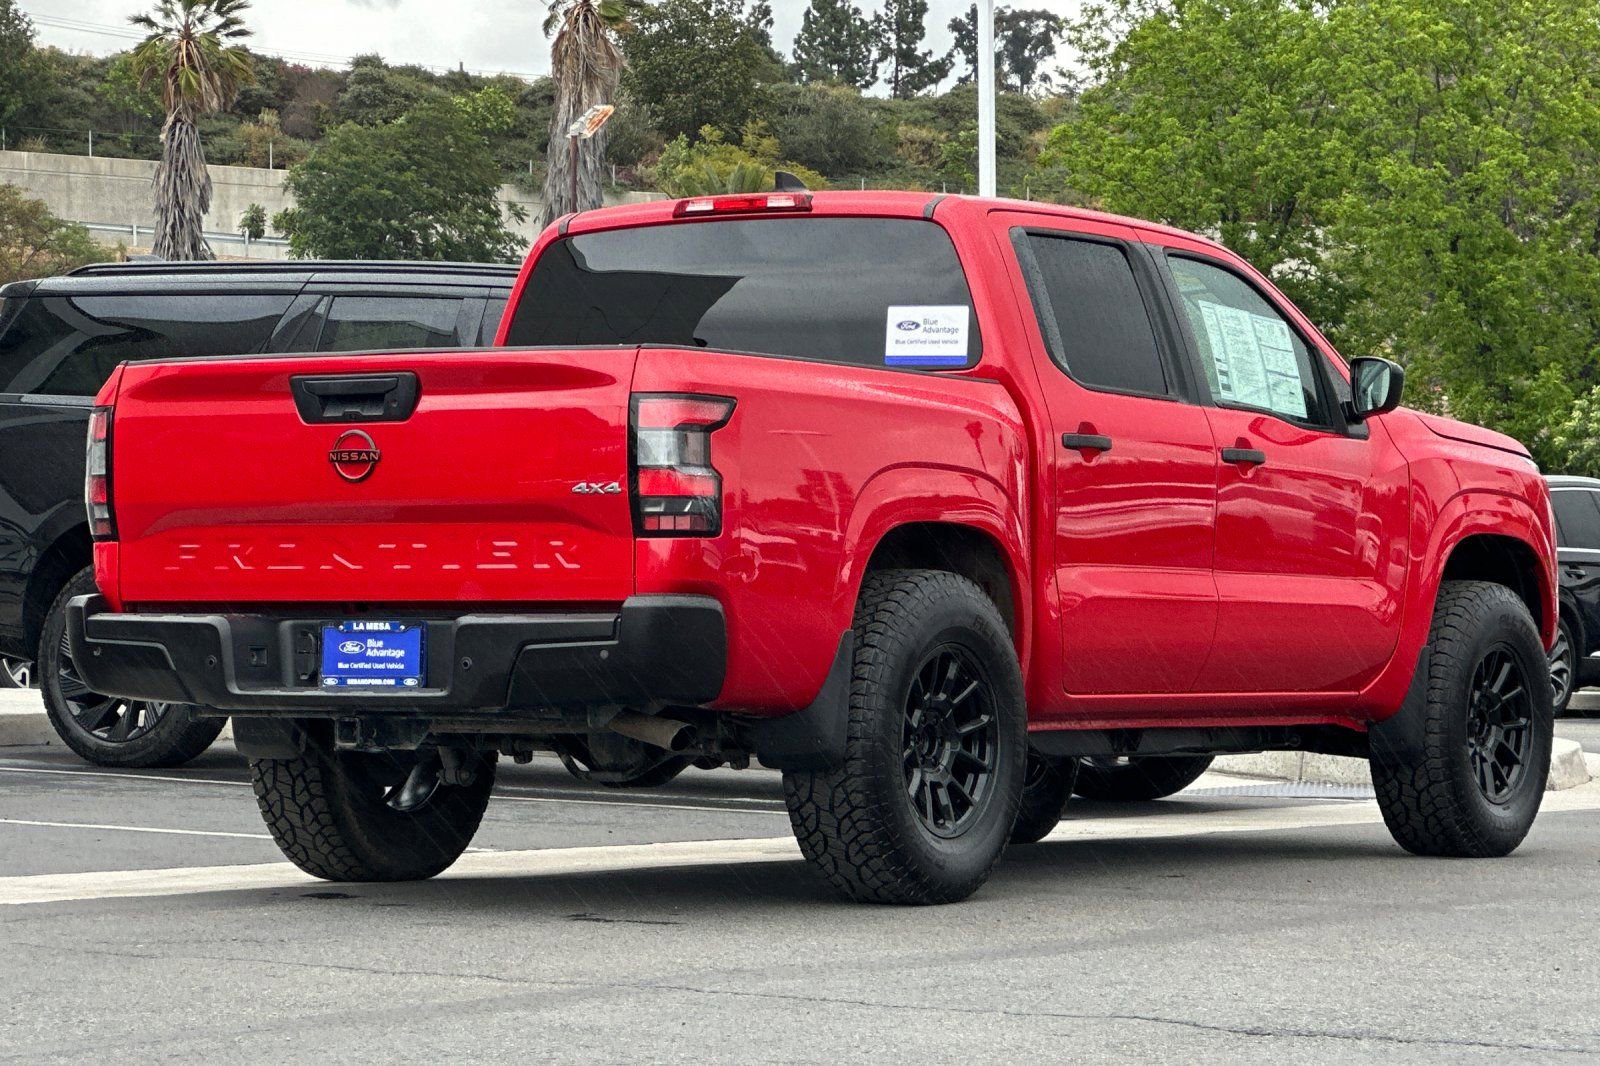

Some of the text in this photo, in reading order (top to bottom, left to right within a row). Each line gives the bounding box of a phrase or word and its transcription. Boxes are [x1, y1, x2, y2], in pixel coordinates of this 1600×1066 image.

[330, 452, 379, 461] NISSAN
[163, 538, 581, 570] FRONTIER
[353, 622, 391, 630] LA MESA
[367, 639, 383, 647] Blue
[366, 648, 405, 658] Advantage
